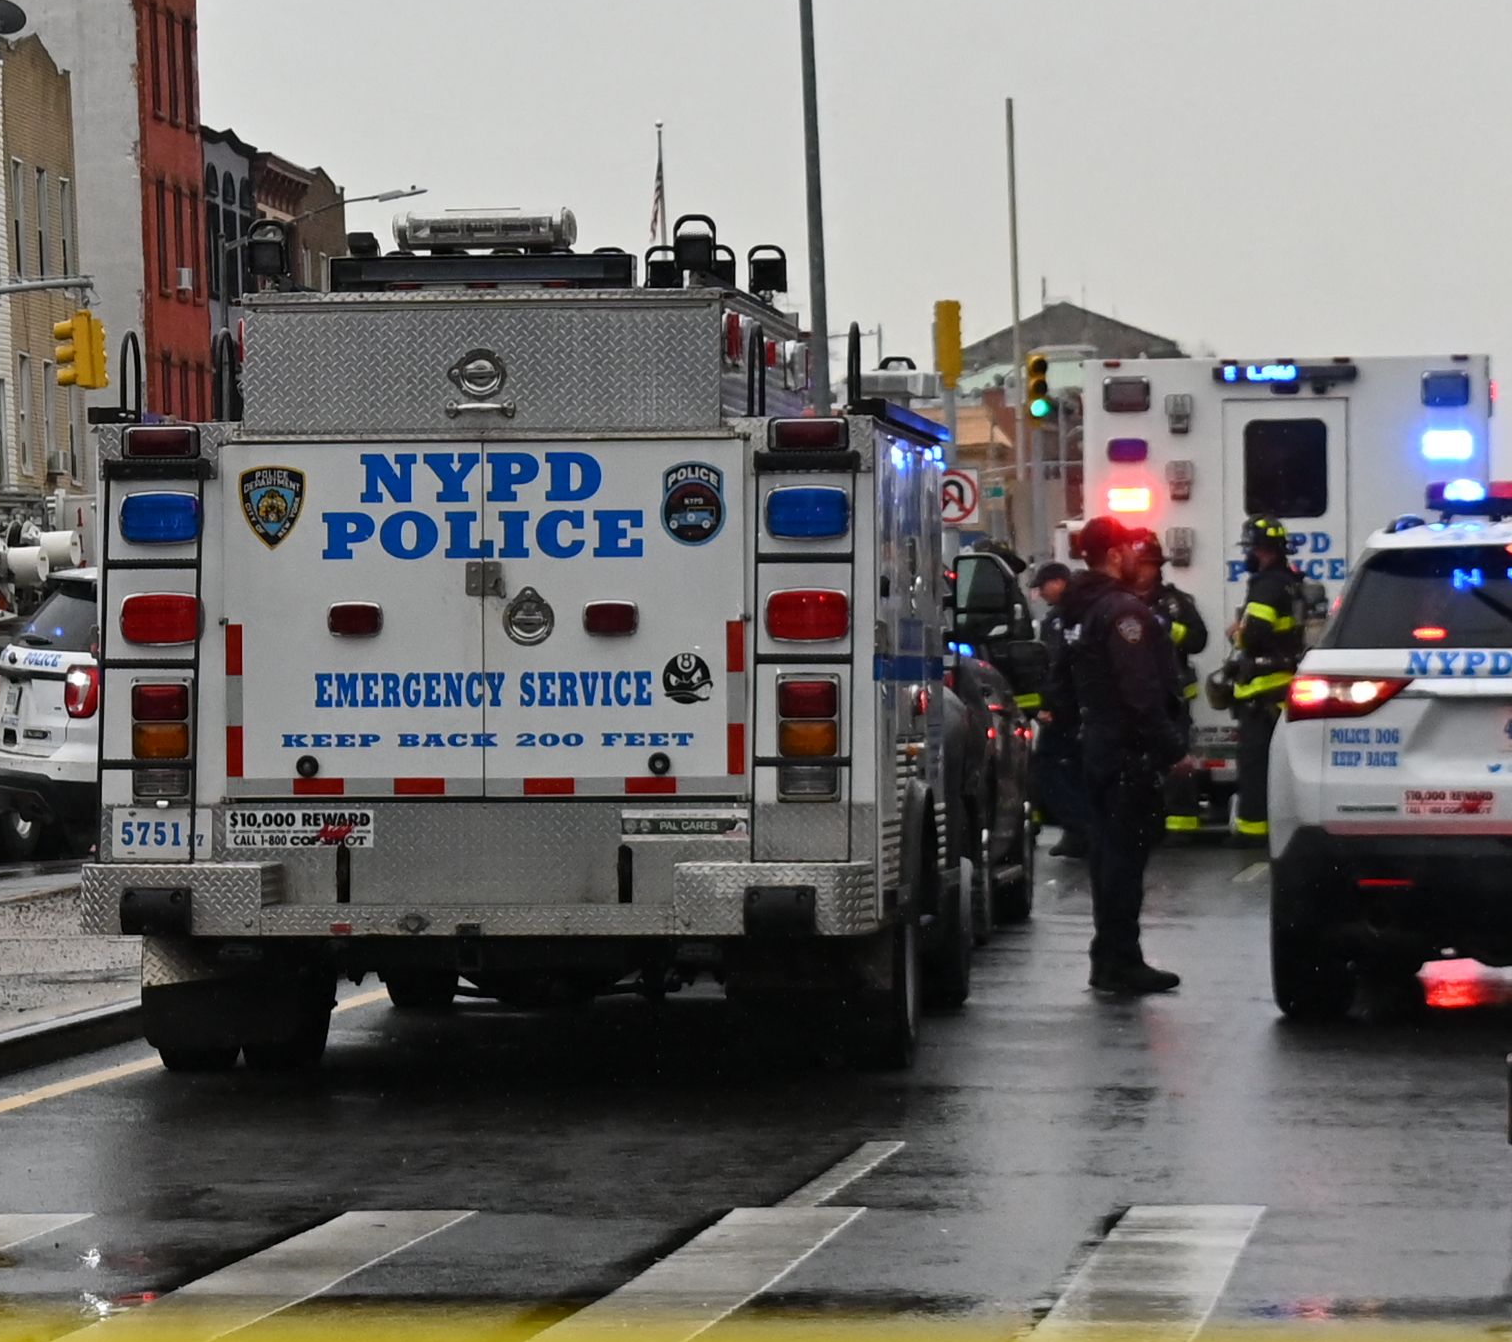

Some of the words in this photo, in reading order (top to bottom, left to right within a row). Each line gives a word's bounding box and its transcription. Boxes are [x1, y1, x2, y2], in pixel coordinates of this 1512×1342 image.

[255, 470, 289, 479] POLICE
[360, 452, 602, 503] NYPD
[667, 467, 719, 488] POLICE
[244, 478, 301, 493] DEPARTMENT
[322, 510, 643, 559] POLICE
[23, 652, 62, 667] POLICE
[315, 672, 505, 708] EMERGENCY
[519, 671, 652, 707] SERVICE
[281, 733, 380, 748] KEEP
[398, 733, 498, 748] BACK
[515, 733, 584, 747] 200
[601, 732, 694, 747] FEET
[1330, 728, 1371, 745] POLICE
[1366, 751, 1399, 767] BACK
[229, 812, 296, 828] $10,000
[302, 812, 371, 827] REWARD
[660, 821, 678, 831] PAL
[681, 821, 718, 831] CARES
[121, 822, 181, 846] 5751
[234, 834, 257, 846] CALL
[261, 834, 287, 846] 1-800
